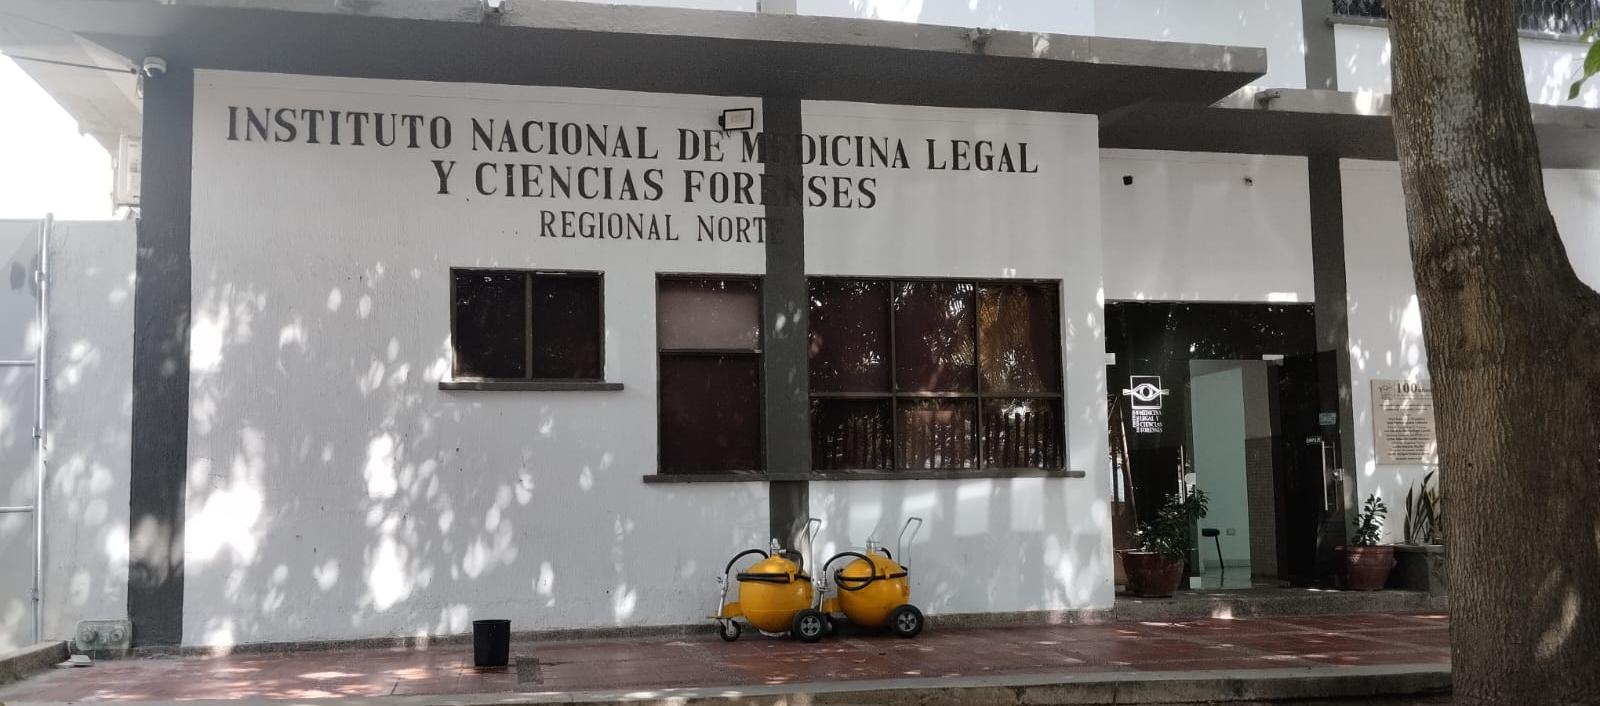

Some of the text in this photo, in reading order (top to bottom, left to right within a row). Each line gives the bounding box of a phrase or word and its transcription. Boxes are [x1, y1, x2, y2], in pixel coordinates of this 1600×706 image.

[227, 106, 452, 150] INSTITUTO
[471, 117, 659, 160] NACIONAL
[677, 128, 725, 163] DE
[925, 138, 1039, 174] LEGAL
[430, 160, 456, 195] Y
[475, 161, 664, 202] CIENCIAS
[539, 210, 784, 245] REGIONAL NORTE
[1397, 382, 1418, 394] 100
